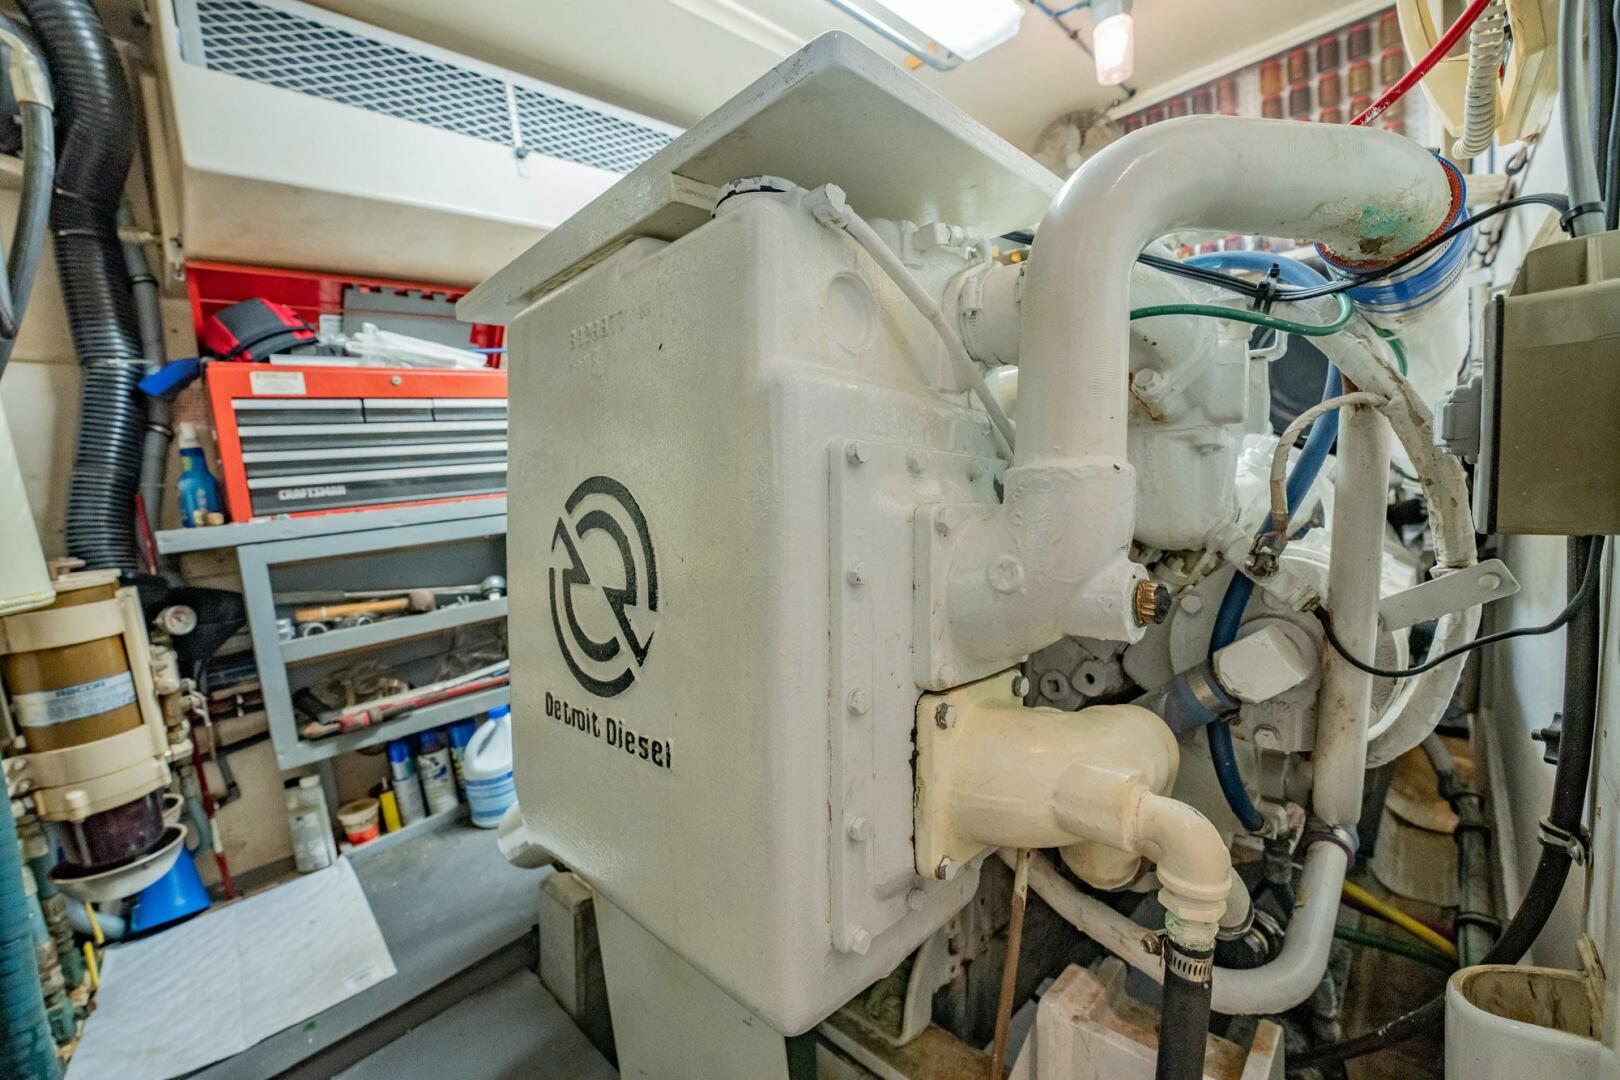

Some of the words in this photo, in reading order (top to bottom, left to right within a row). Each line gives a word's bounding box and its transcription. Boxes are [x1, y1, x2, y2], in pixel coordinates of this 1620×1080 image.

[278, 485, 347, 500] CRAFTSMAN
[545, 691, 600, 738] Detroit
[606, 717, 671, 769] Diesel
